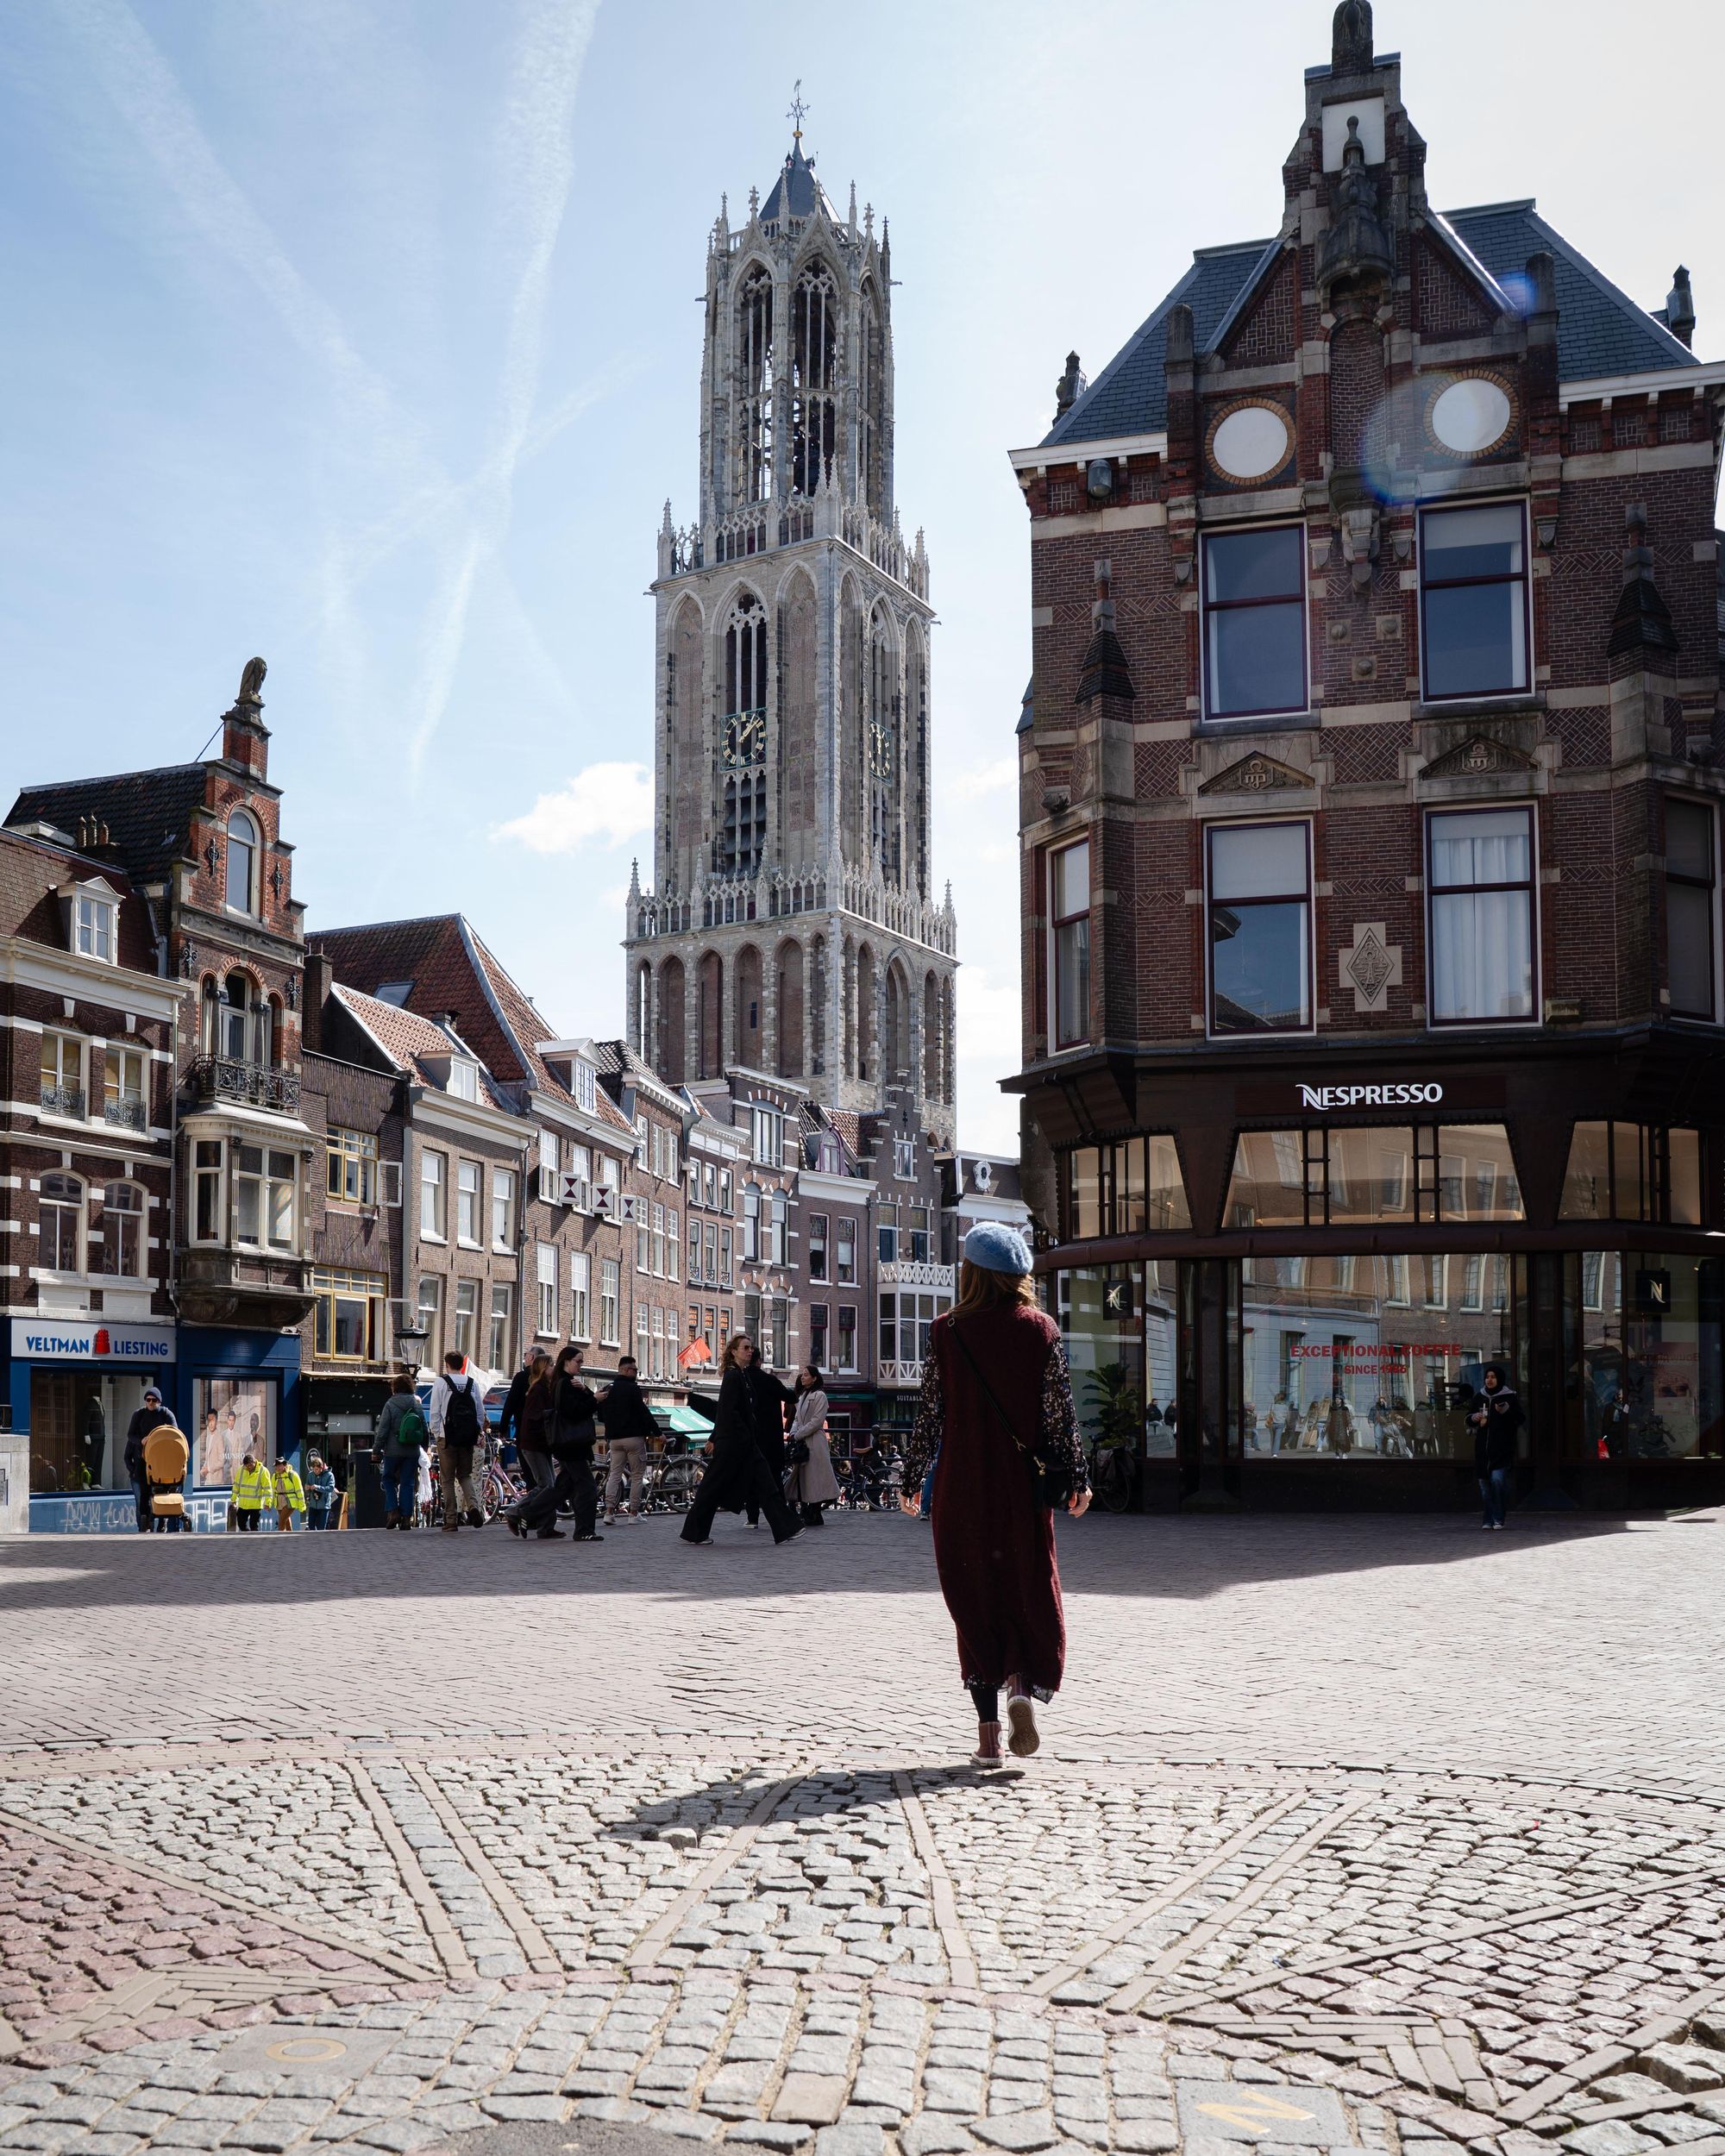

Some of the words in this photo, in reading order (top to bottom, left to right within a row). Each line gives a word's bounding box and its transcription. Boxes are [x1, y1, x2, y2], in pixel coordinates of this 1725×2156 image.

[1295, 1082, 1443, 1111] NESPRESSO
[26, 1336, 90, 1354] VELTMAN
[114, 1340, 168, 1357] LIESTING
[1290, 1344, 1398, 1357] EXCEPTIONAL
[1401, 1343, 1462, 1357] COFFEE
[1344, 1364, 1377, 1375] SINCE
[1380, 1364, 1408, 1375] 1986
